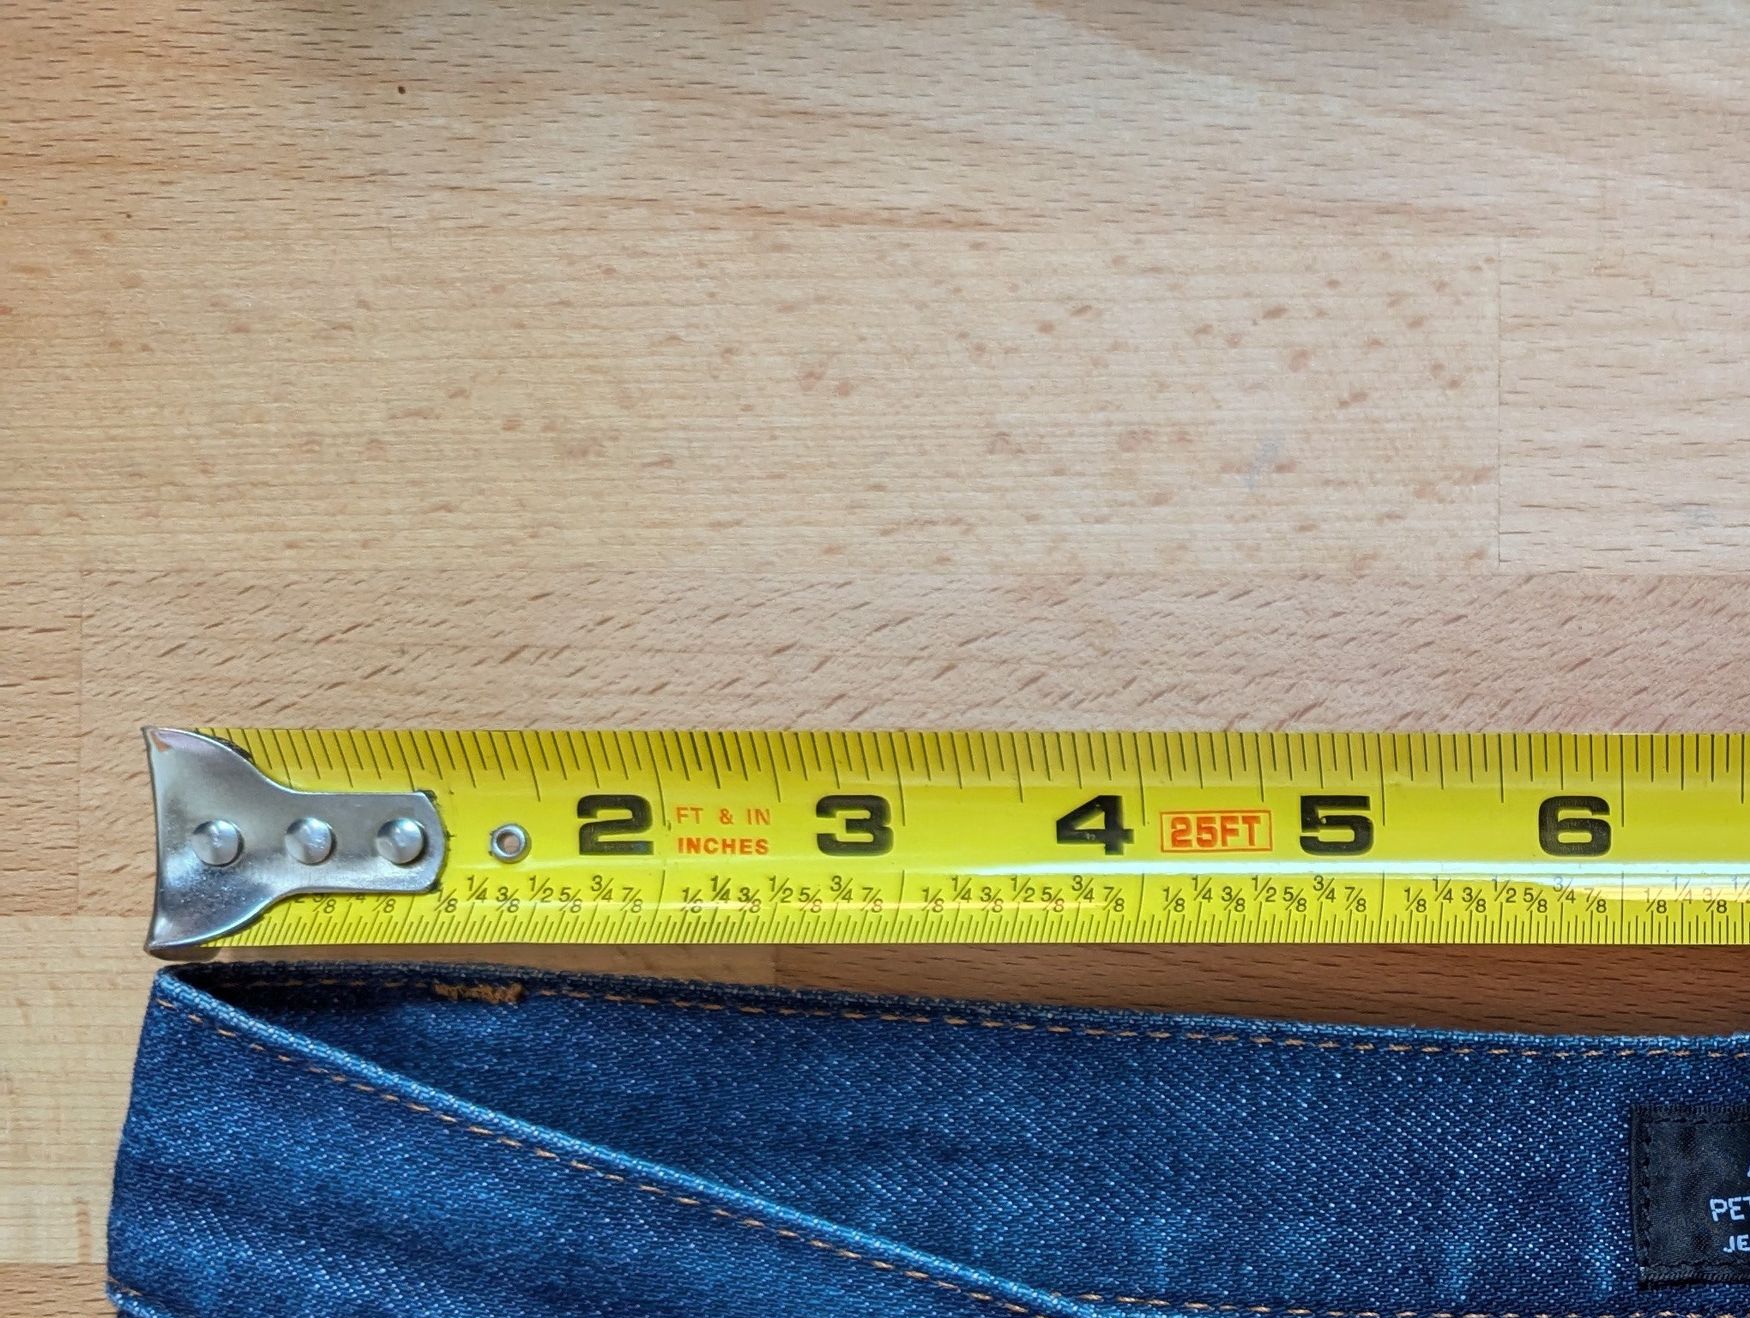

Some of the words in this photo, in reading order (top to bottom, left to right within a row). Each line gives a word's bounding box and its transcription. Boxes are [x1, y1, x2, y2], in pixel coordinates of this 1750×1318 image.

[577, 795, 653, 856] 2
[676, 806, 702, 825] FT
[718, 806, 735, 825] &
[747, 806, 771, 825] IN
[815, 795, 893, 857] 3
[1056, 795, 1135, 856] 4
[1170, 816, 1262, 847] 25FT
[1299, 795, 1373, 856] 5
[1538, 795, 1612, 857] 6
[677, 838, 769, 855] INCHES
